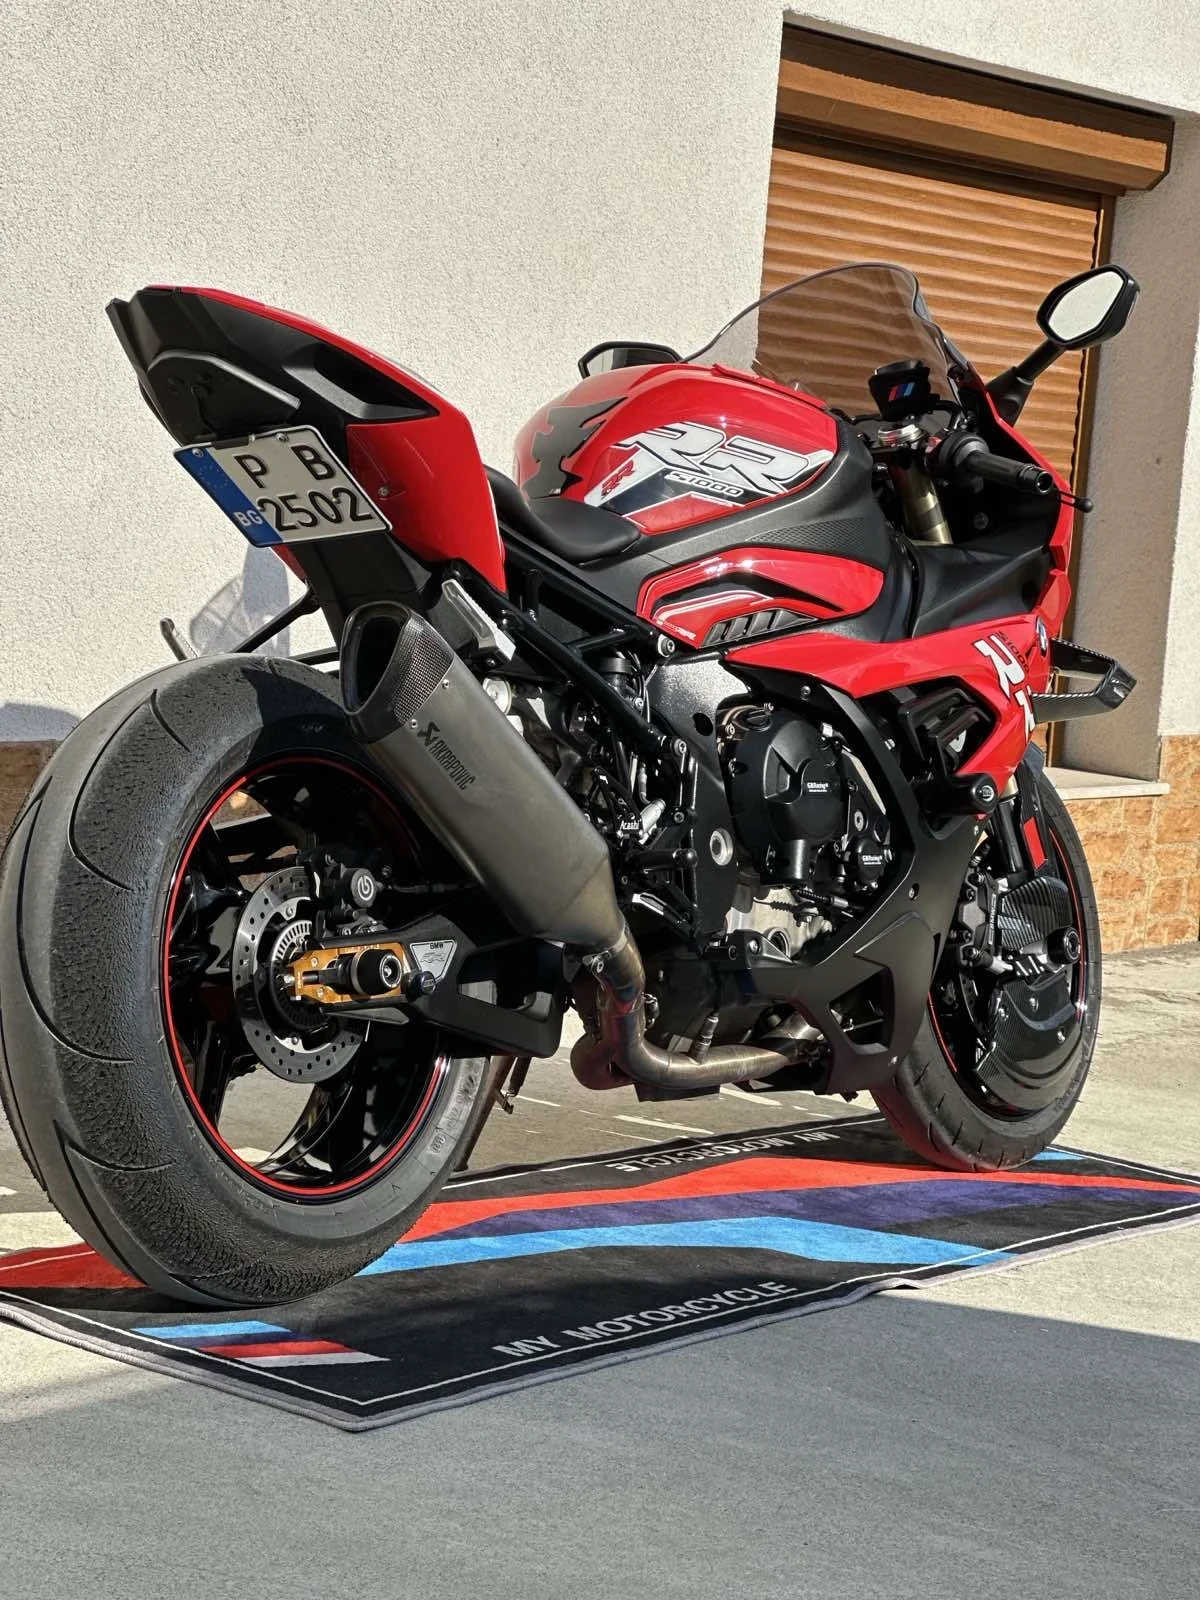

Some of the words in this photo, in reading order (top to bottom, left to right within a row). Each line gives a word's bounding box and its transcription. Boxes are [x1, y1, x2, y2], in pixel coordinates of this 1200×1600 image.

[232, 454, 268, 489] P
[290, 444, 336, 481] B
[664, 470, 744, 497] S1000
[234, 510, 264, 528] BG
[256, 486, 375, 532] 2502
[492, 1335, 562, 1357] MY
[561, 1281, 798, 1341] MOTORCYCLE
